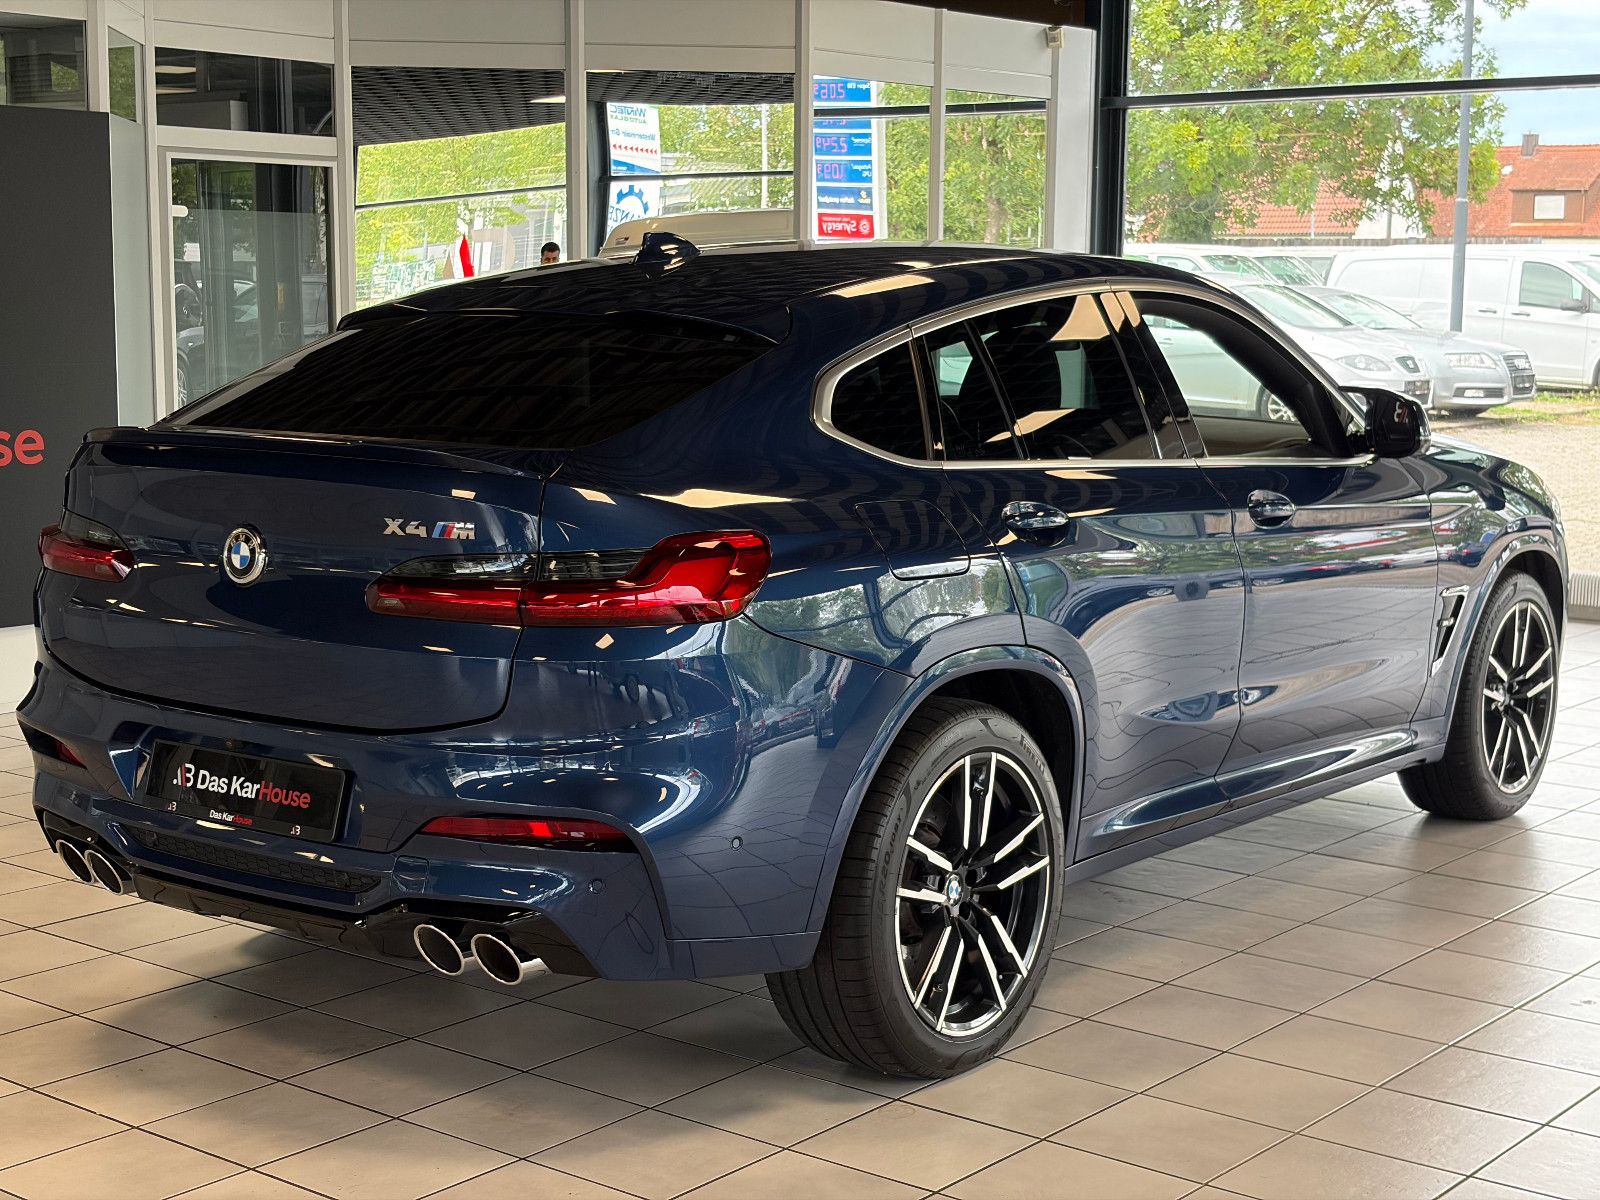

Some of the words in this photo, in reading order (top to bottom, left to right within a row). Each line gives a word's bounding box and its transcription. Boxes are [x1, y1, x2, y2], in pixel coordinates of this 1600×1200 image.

[383, 517, 428, 538] X4
[196, 769, 228, 794] Das
[209, 809, 223, 821] Das
